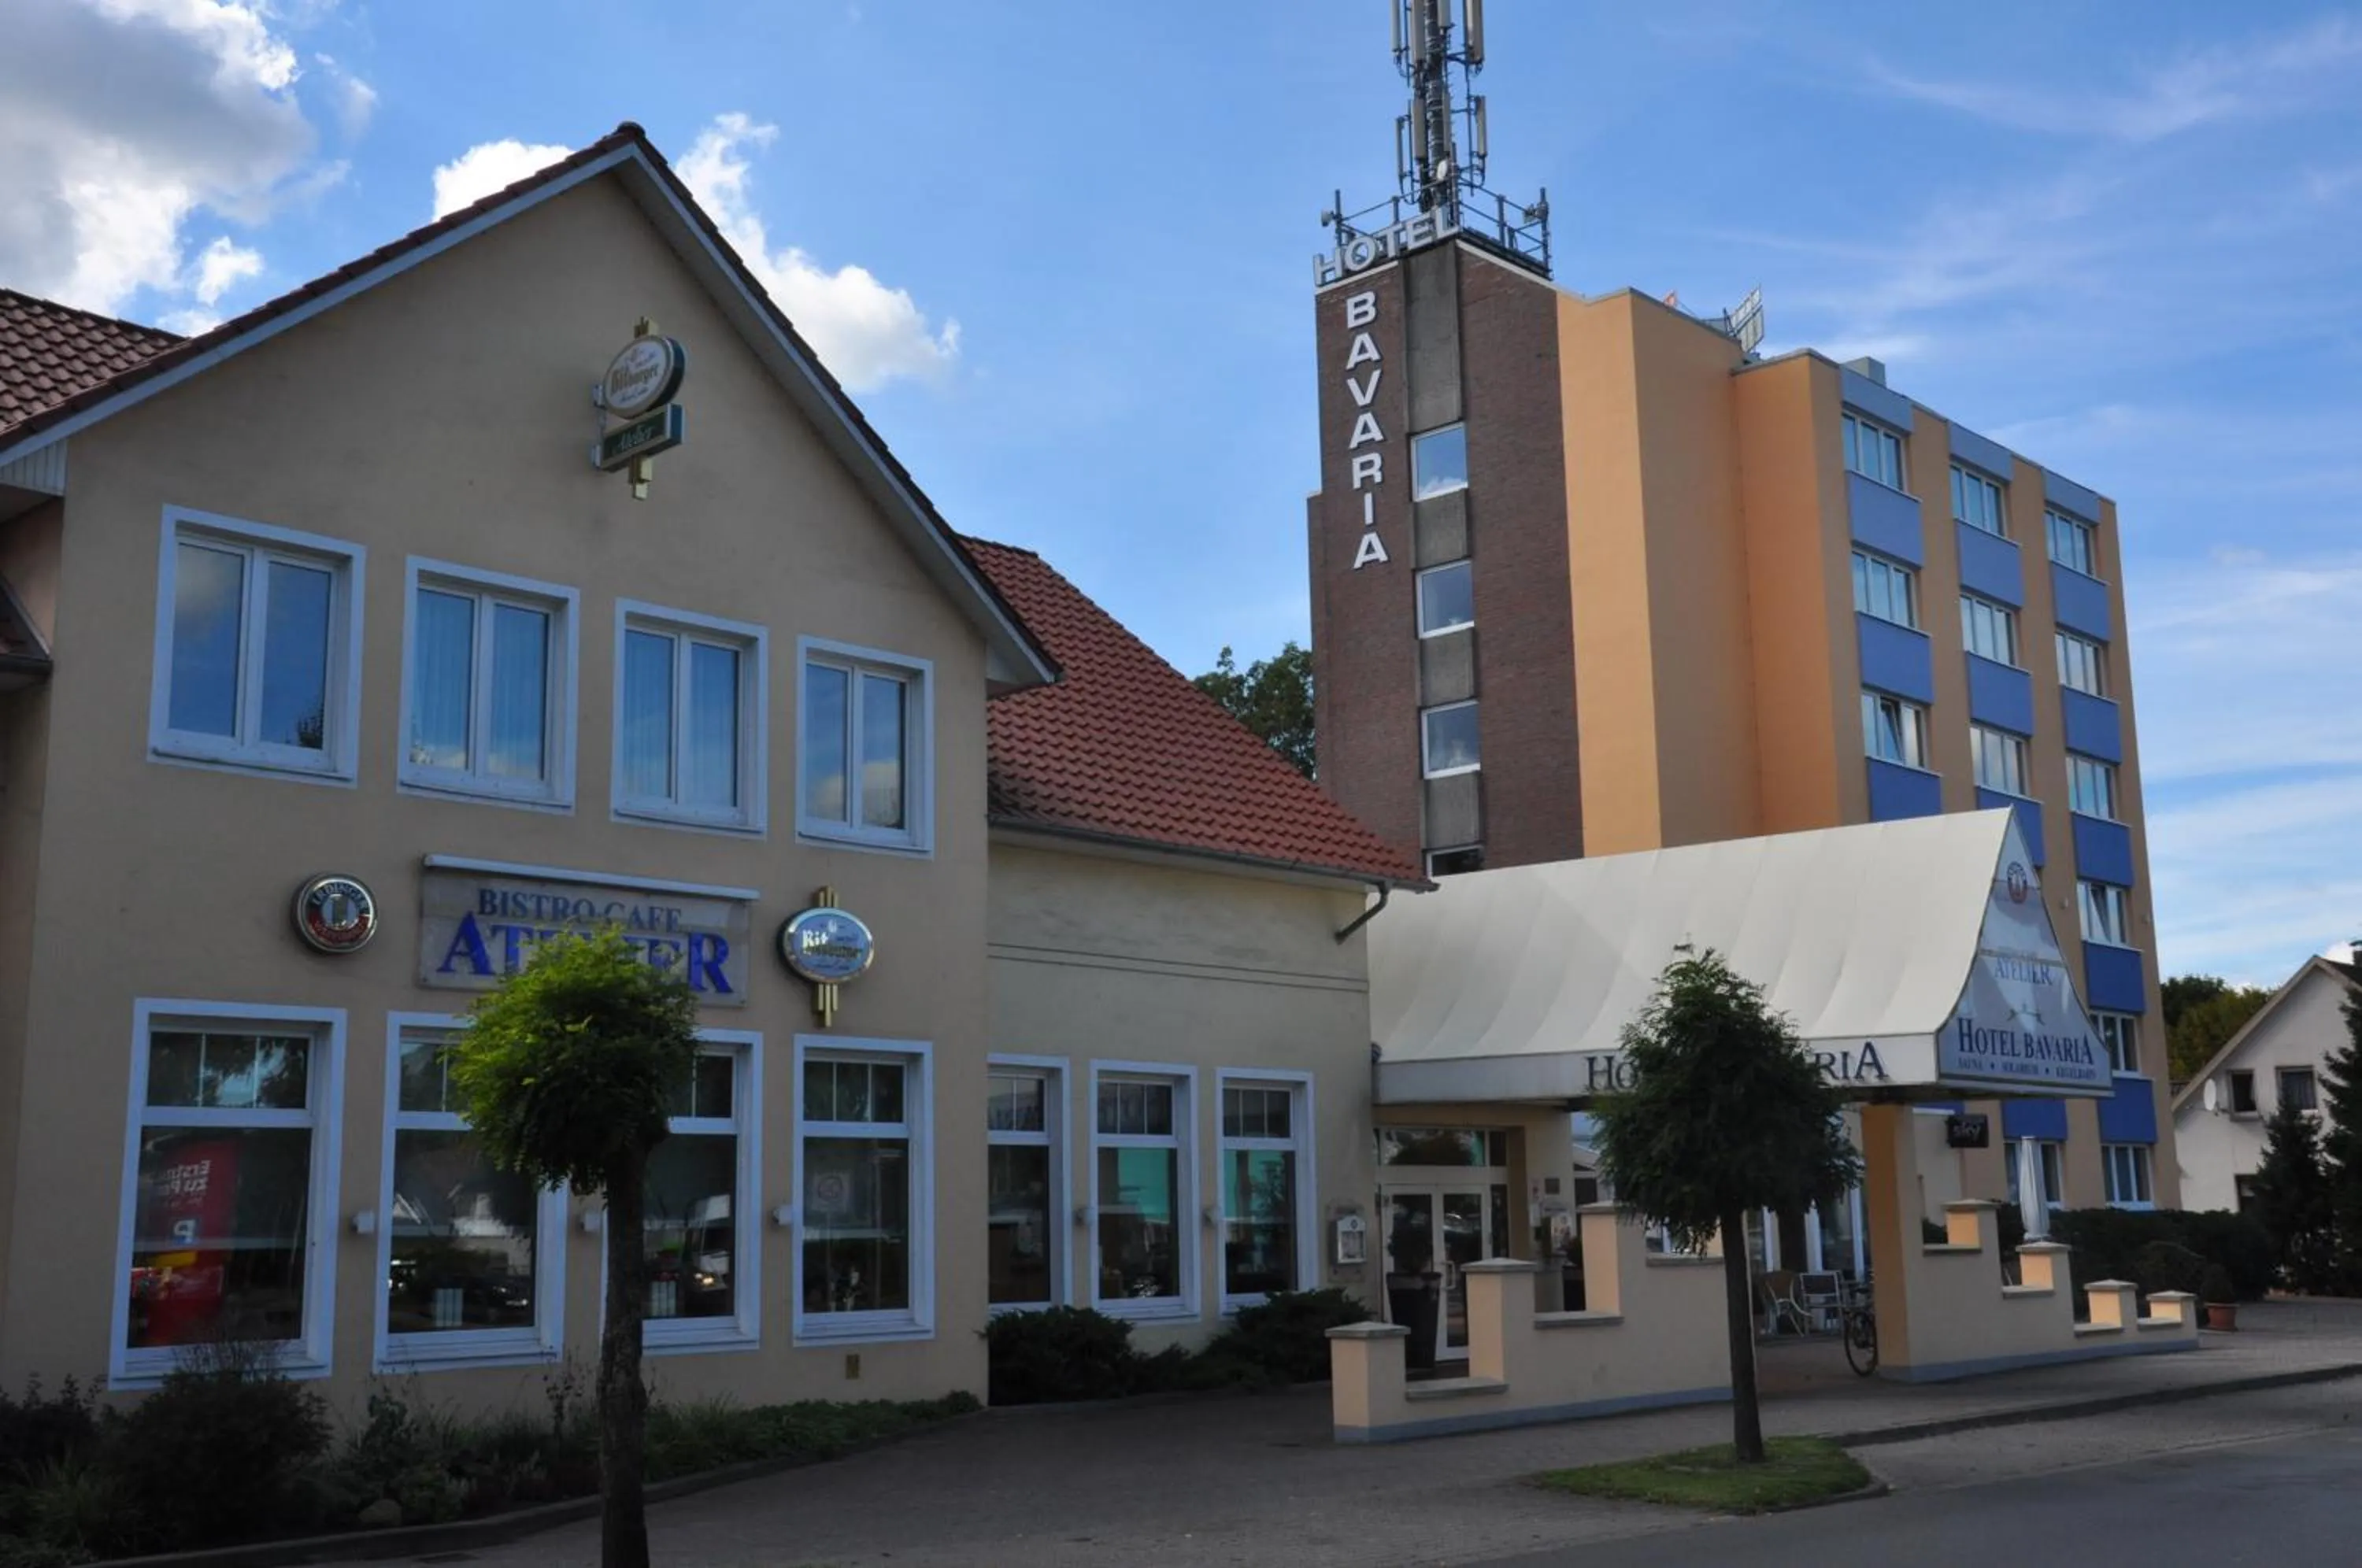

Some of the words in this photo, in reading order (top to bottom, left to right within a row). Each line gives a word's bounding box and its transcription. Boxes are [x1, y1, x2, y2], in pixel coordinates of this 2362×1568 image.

[1313, 206, 1461, 287] HOTEL
[1346, 290, 1389, 571] BAVARIA
[436, 910, 734, 993] ATER
[1994, 957, 2053, 986] ATELIER
[1957, 1017, 2021, 1057] HOTEL
[2023, 1032, 2094, 1065] BAVARIA
[1953, 1120, 1982, 1143] sky
